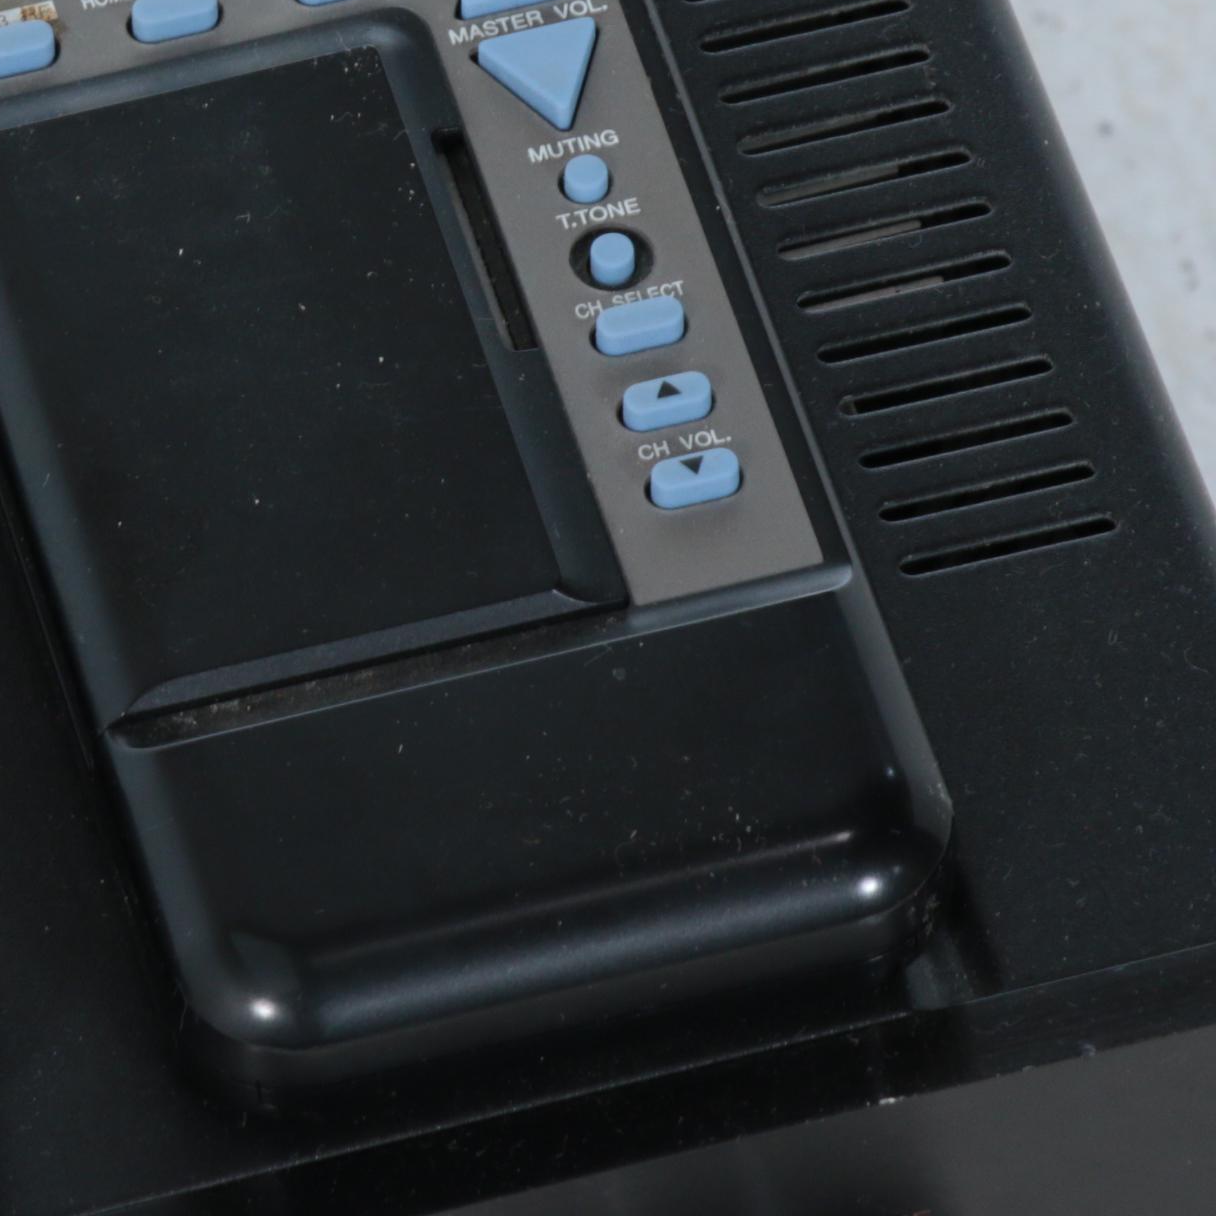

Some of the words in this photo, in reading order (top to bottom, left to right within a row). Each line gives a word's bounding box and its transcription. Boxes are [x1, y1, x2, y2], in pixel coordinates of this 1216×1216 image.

[449, 10, 543, 46] MASTER
[527, 129, 620, 164] MUTING
[555, 197, 642, 230] T.TONE
[575, 300, 602, 319] CH
[638, 441, 670, 461] CH
[679, 429, 732, 451] VOL.
